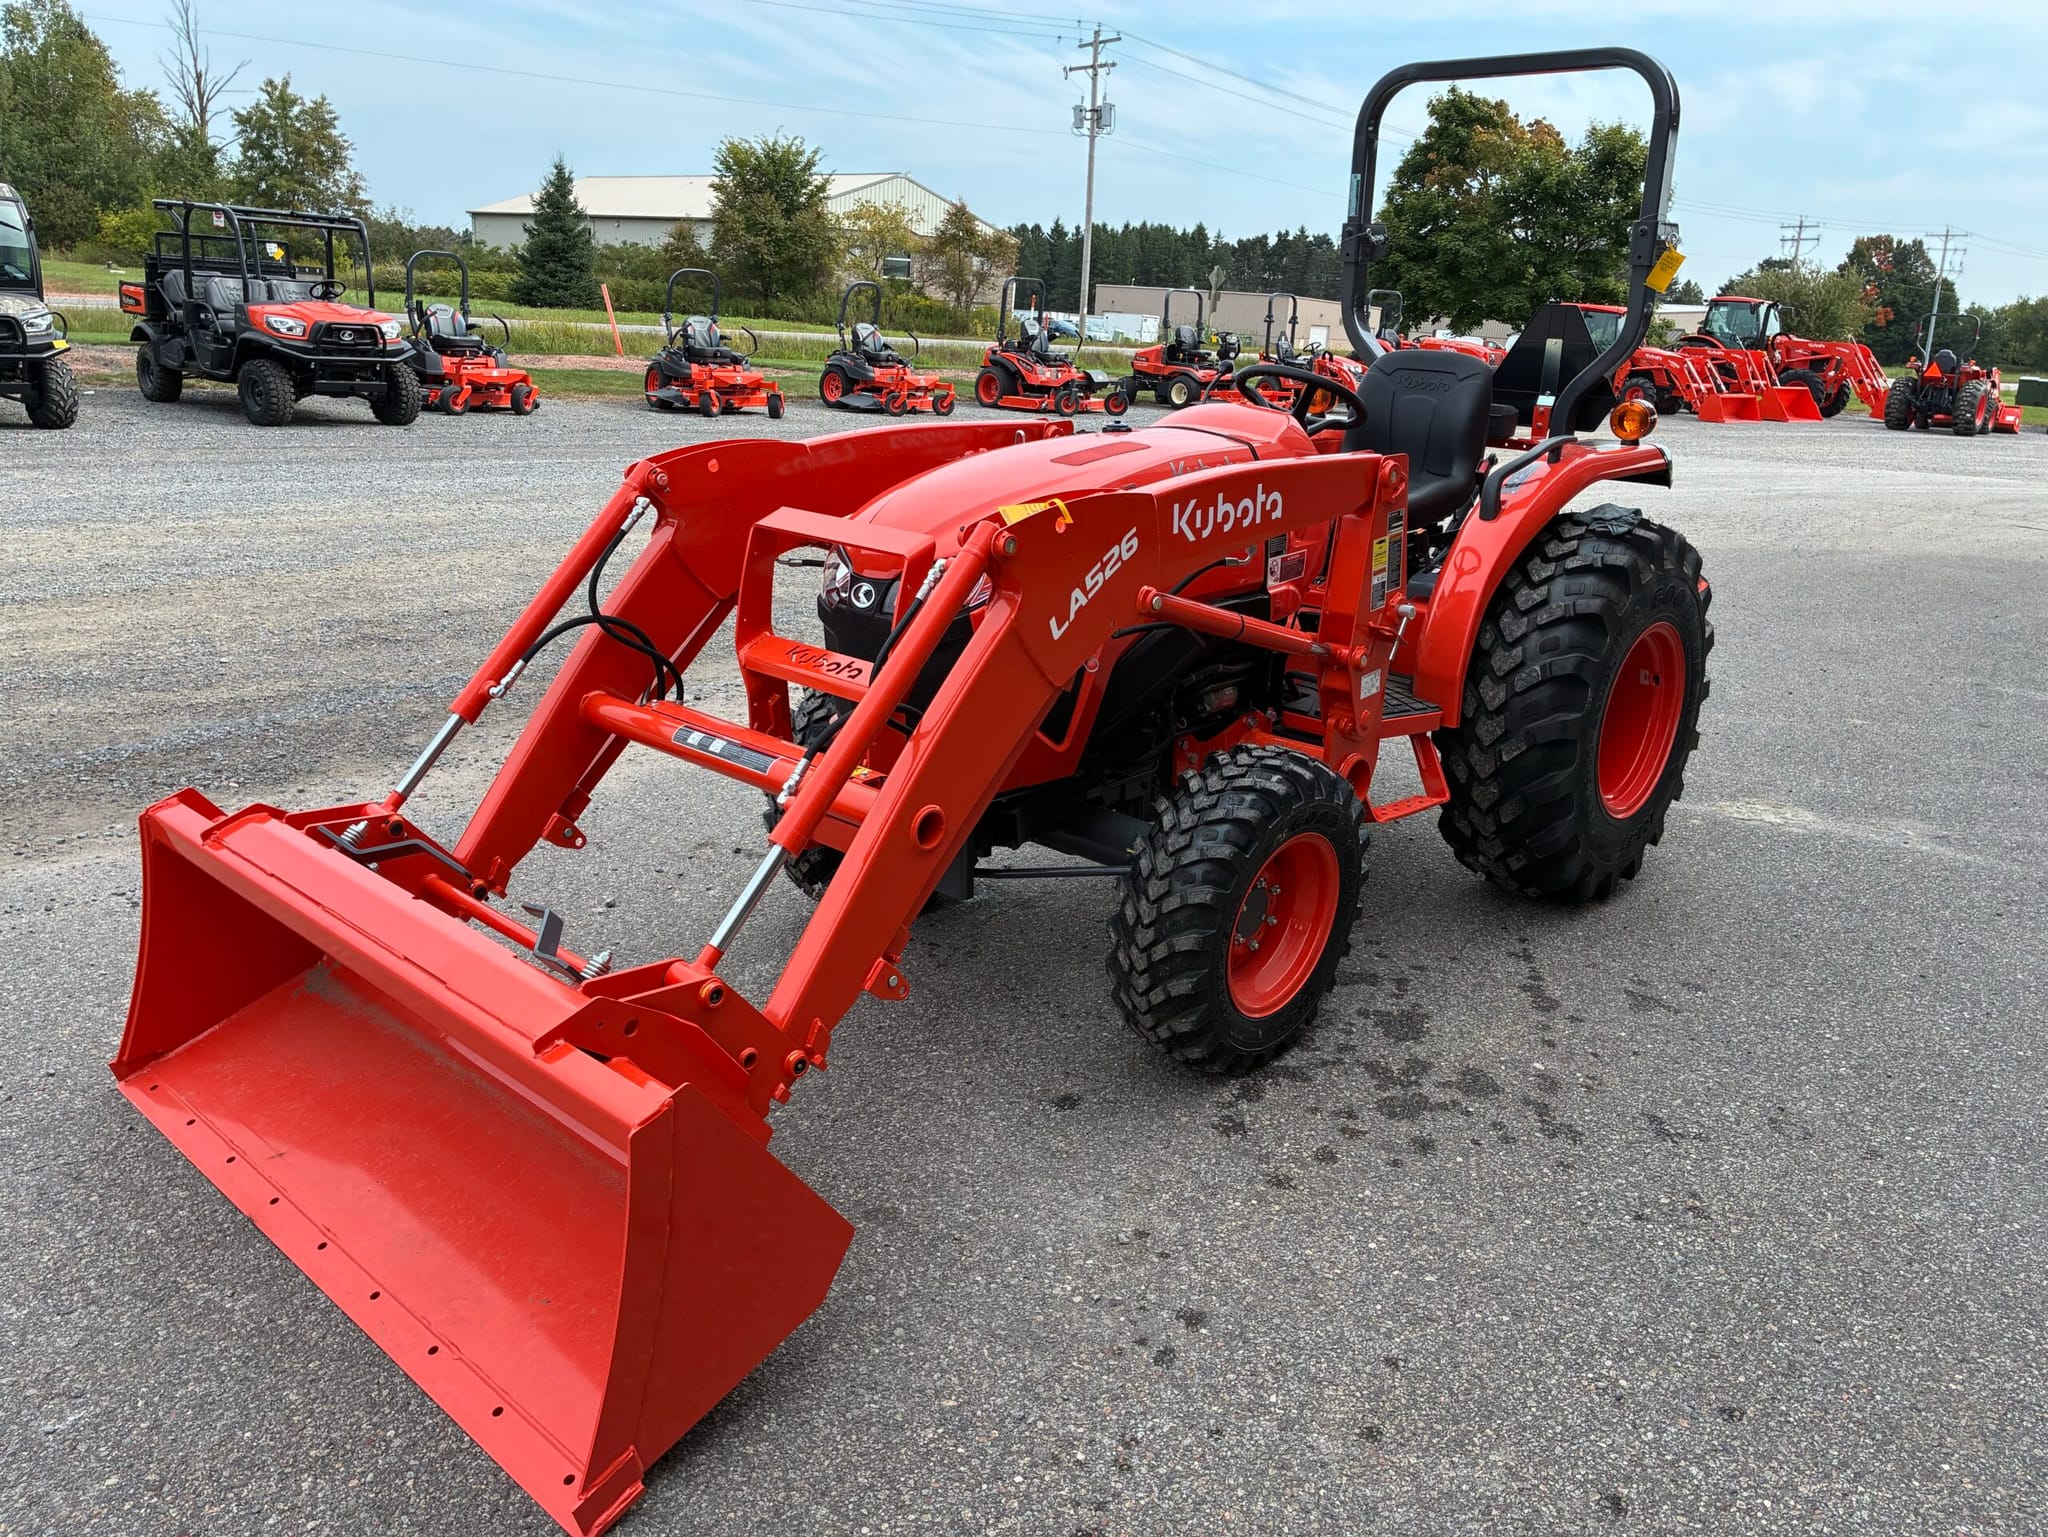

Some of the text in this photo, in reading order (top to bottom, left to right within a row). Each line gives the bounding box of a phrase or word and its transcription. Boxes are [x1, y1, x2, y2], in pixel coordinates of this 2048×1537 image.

[1400, 375, 1450, 392] Kubota
[1172, 484, 1283, 542] Kubota
[1049, 526, 1139, 640] LA526
[785, 645, 863, 680] Kubota
